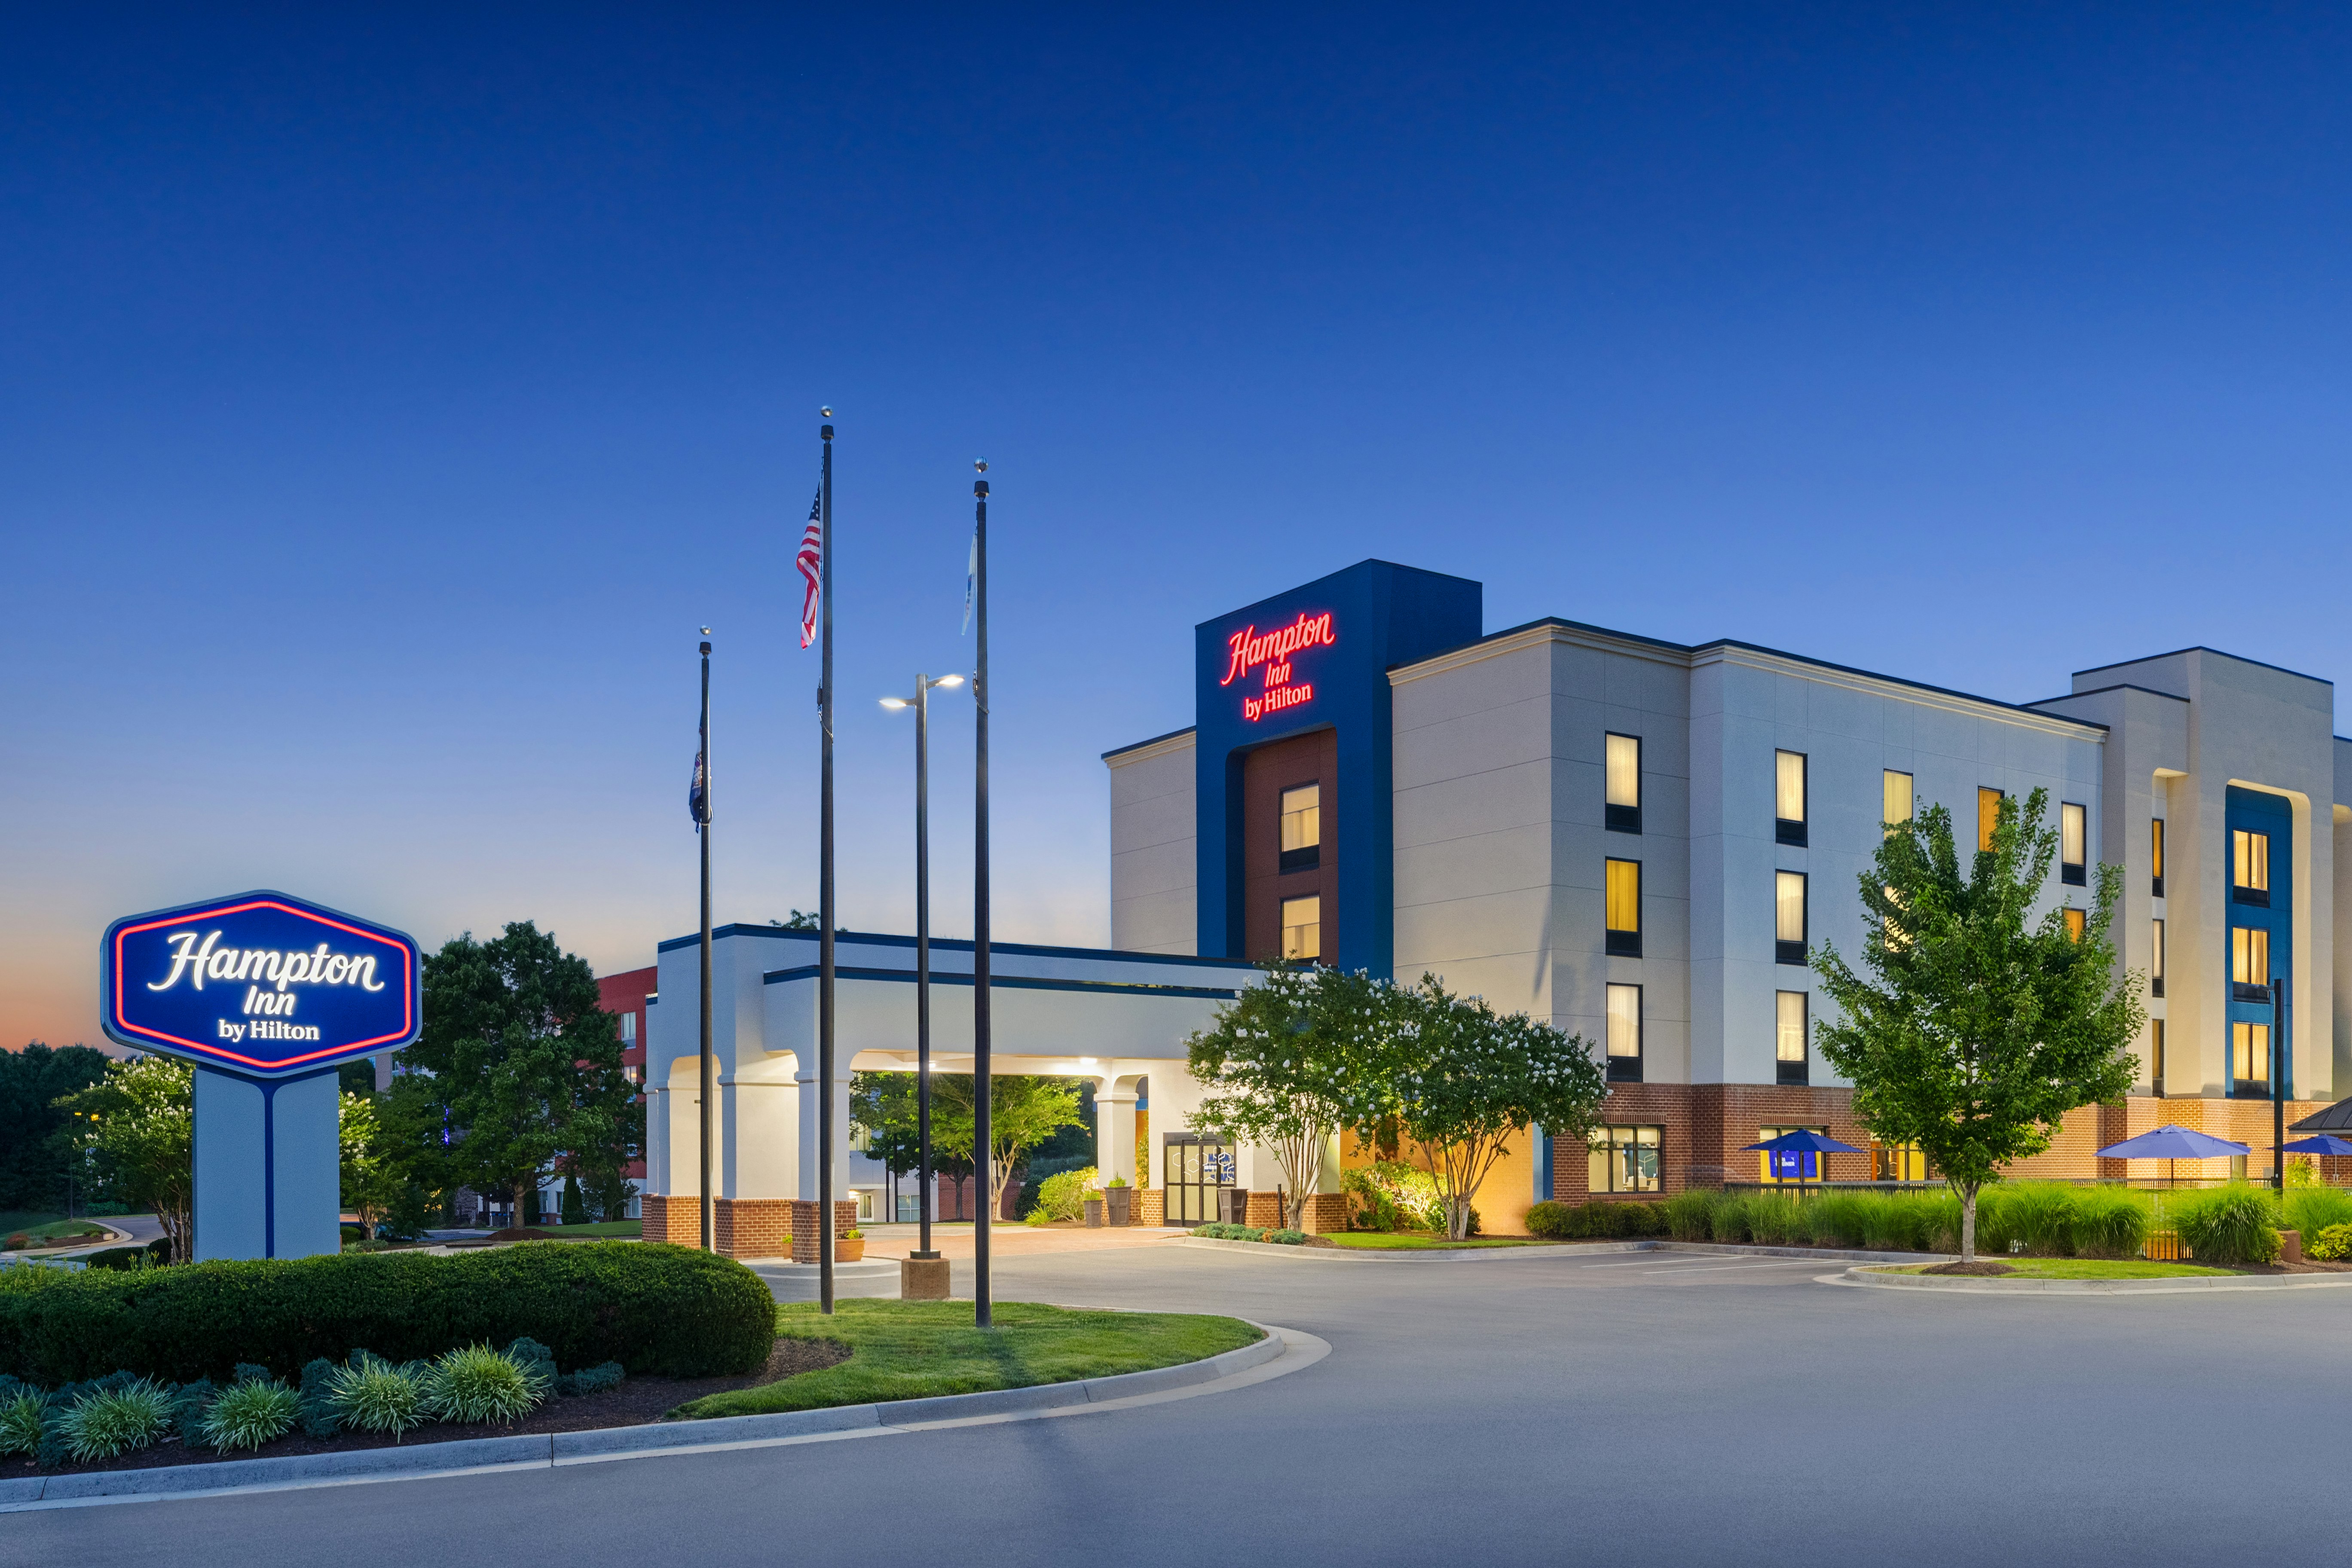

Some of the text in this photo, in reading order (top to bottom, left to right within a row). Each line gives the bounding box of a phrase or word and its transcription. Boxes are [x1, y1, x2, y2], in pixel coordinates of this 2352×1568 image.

[1220, 613, 1336, 686] Hampton
[1264, 662, 1291, 688] Inn
[1244, 684, 1312, 722] by Hilton
[147, 929, 385, 992] Hampton
[243, 984, 296, 1016] Inn
[219, 1019, 320, 1042] by Hilton
